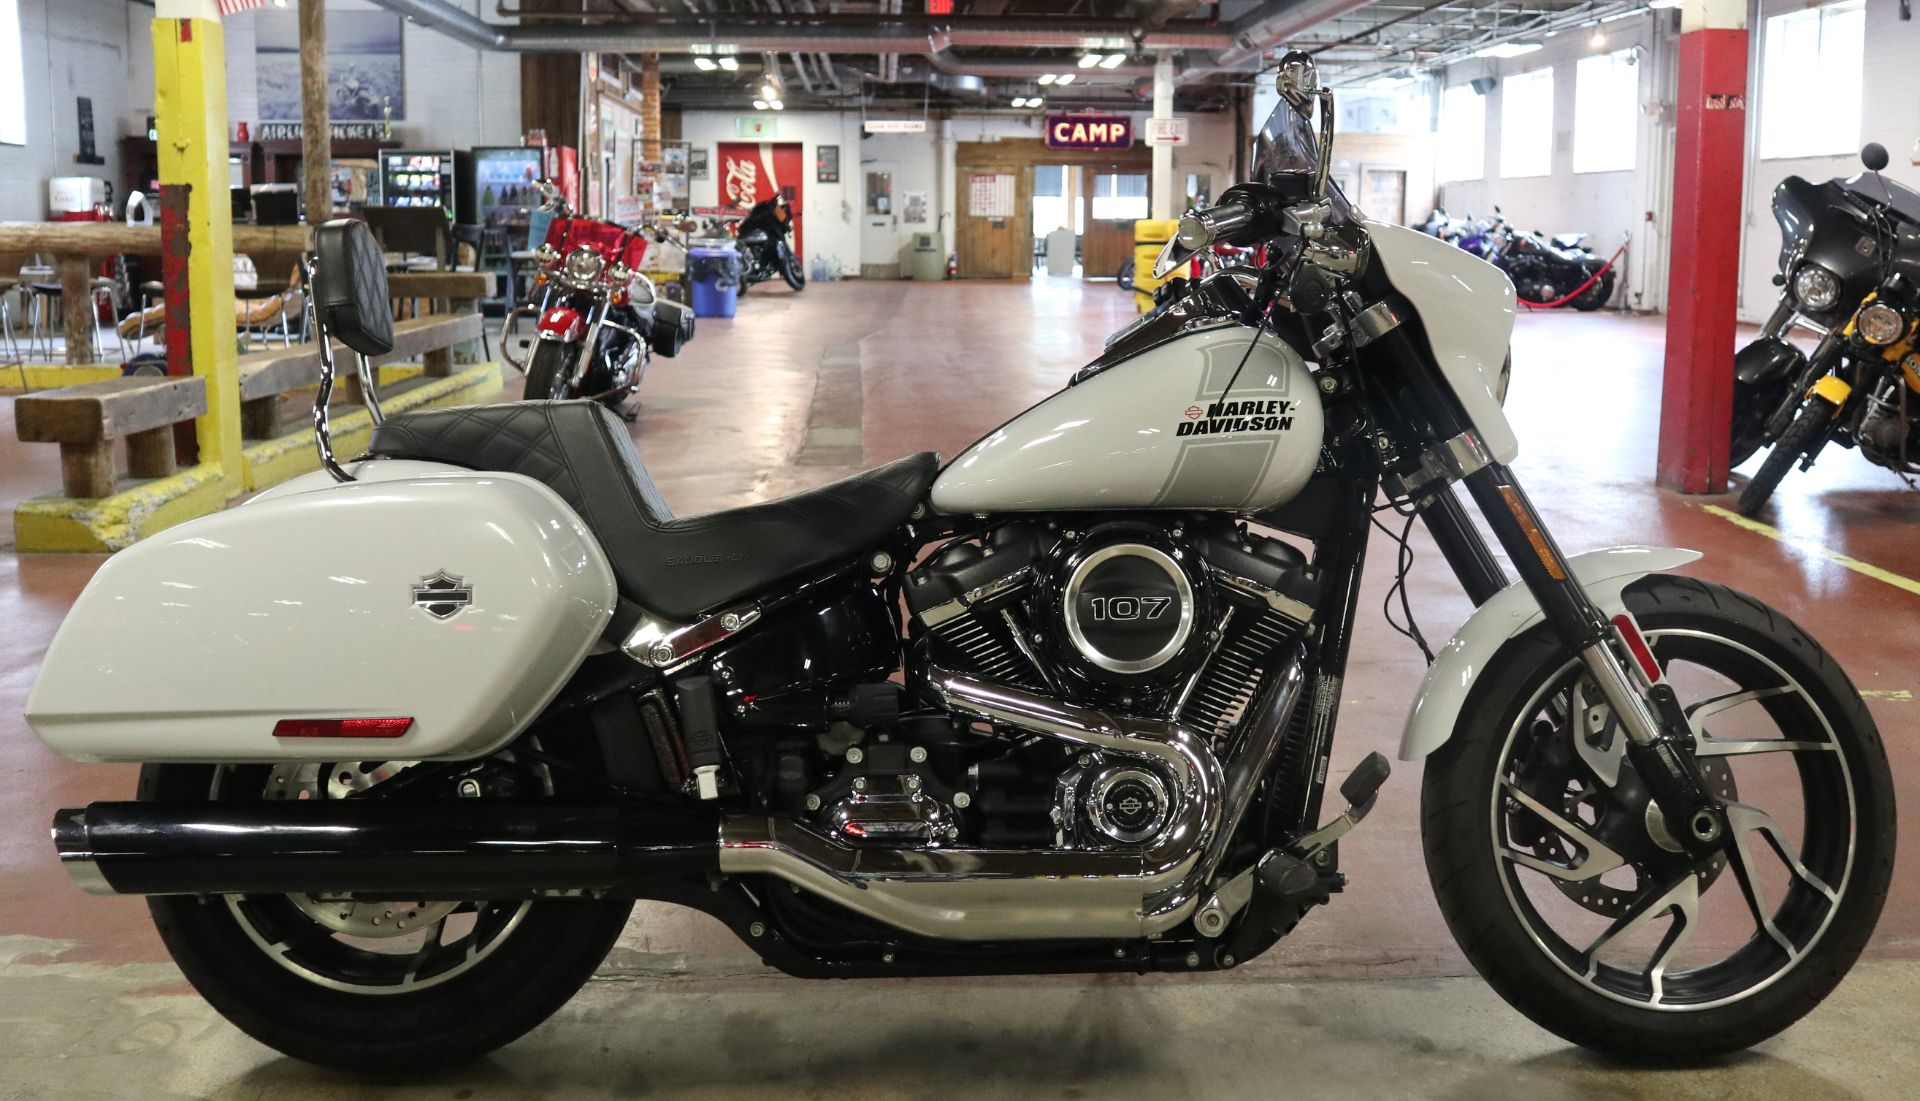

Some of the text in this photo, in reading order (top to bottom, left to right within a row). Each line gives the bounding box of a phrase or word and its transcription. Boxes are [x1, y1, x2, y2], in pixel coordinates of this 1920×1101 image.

[1053, 122, 1126, 143] CAMP
[725, 156, 757, 210] Cola
[1206, 400, 1296, 418] HARLEY-
[1175, 416, 1293, 437] DAVIDSON
[1091, 596, 1172, 621] 107
